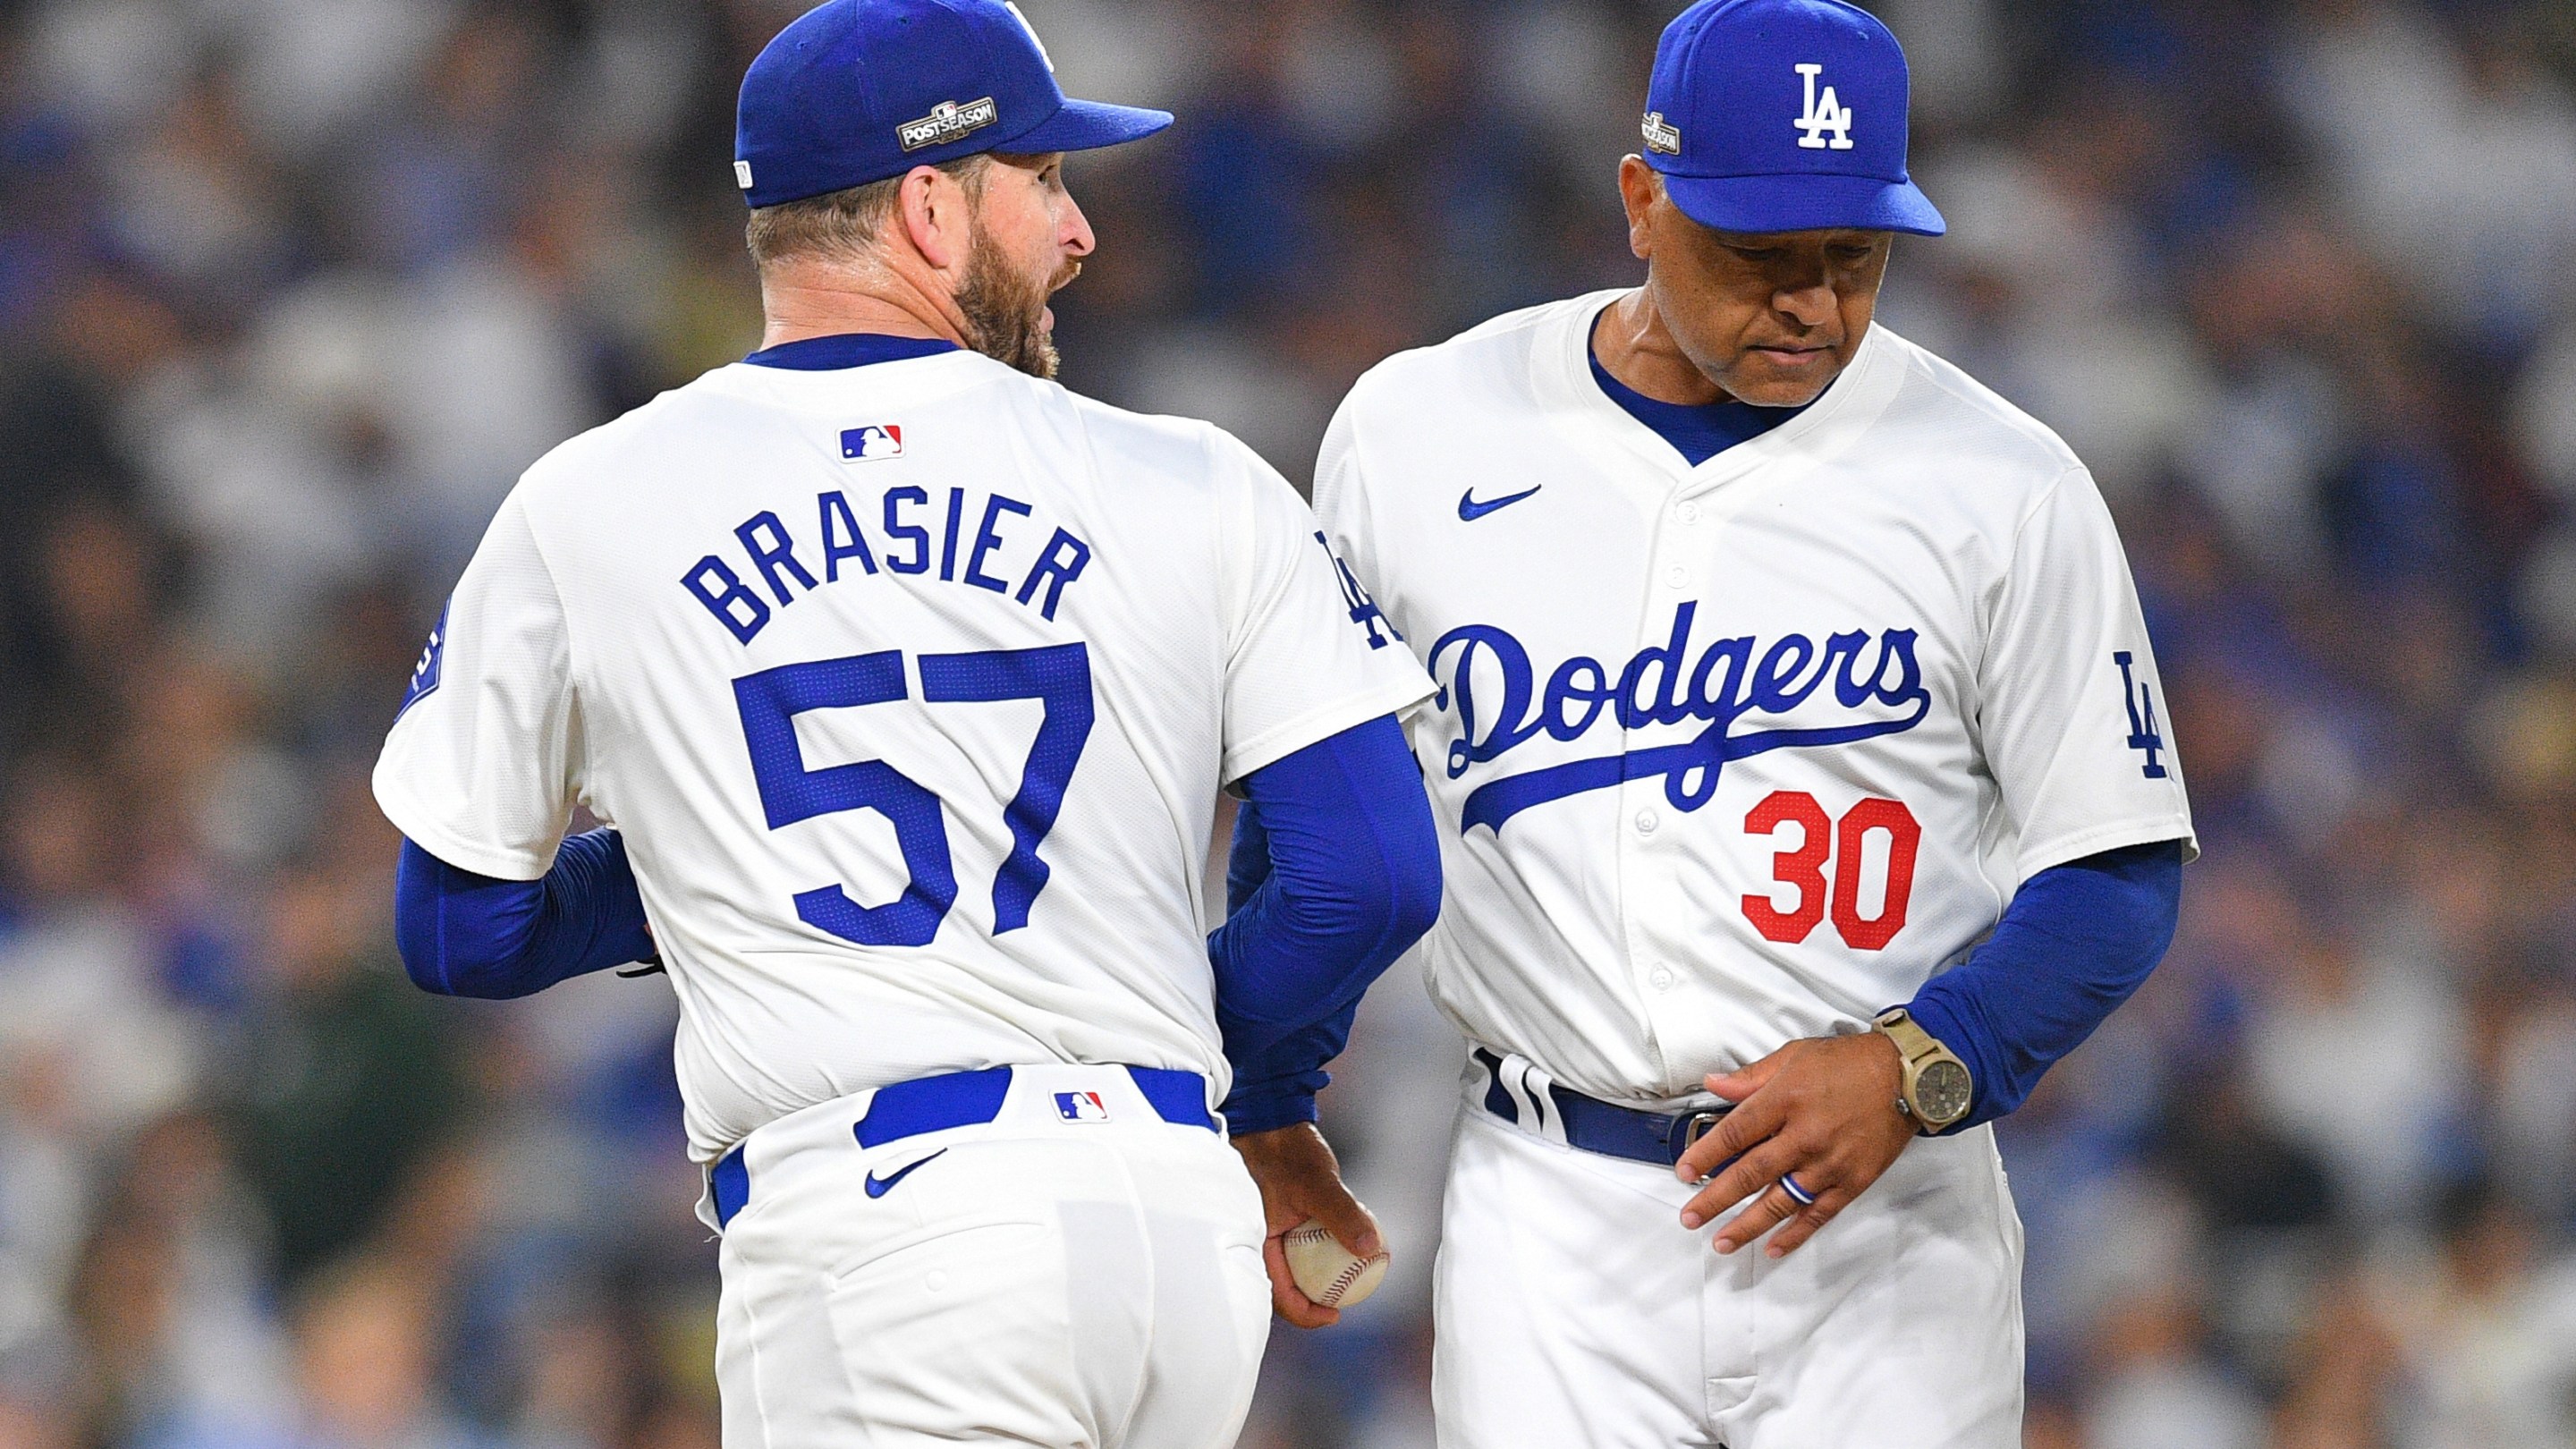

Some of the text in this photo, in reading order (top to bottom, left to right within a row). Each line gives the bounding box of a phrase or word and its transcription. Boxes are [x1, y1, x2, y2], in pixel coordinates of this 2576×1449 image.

[902, 104, 994, 145] POSTSEASON
[1793, 64, 1853, 149] LA
[680, 485, 1091, 646] BRASIER
[1313, 530, 1404, 651] LA
[1428, 600, 1931, 813] Dodgers
[2113, 650, 2175, 783] LA
[731, 641, 1096, 947] 57
[1741, 790, 1921, 951] 30
